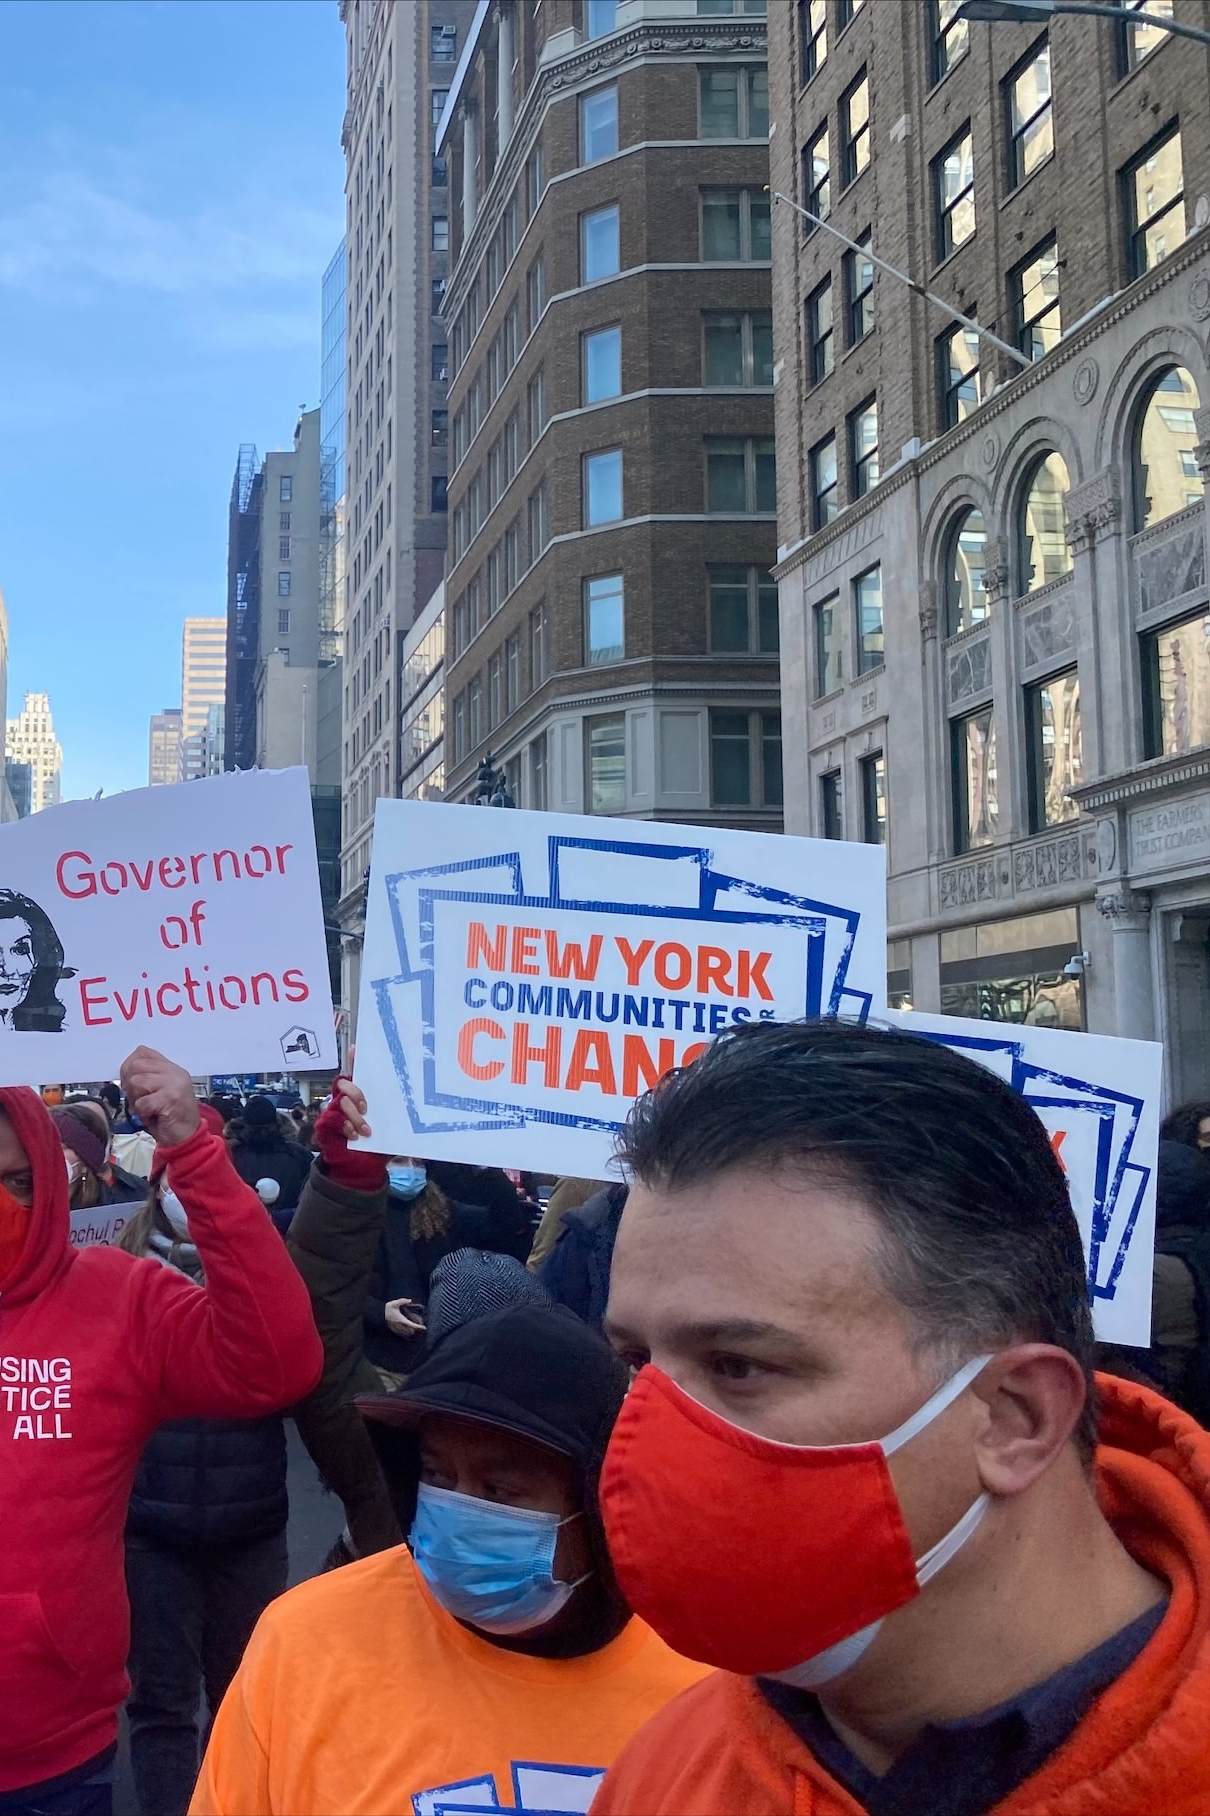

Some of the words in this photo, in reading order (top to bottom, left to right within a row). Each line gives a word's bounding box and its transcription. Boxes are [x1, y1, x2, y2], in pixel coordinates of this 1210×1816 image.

[55, 843, 294, 899] Governor
[159, 899, 207, 950] of
[466, 921, 604, 983] NEW
[614, 935, 775, 1002] YORK
[78, 964, 311, 1027] Evictions
[463, 977, 752, 1035] COMMUNITIES
[457, 1017, 711, 1098] CHAN
[13, 1413, 73, 1440] ALL
